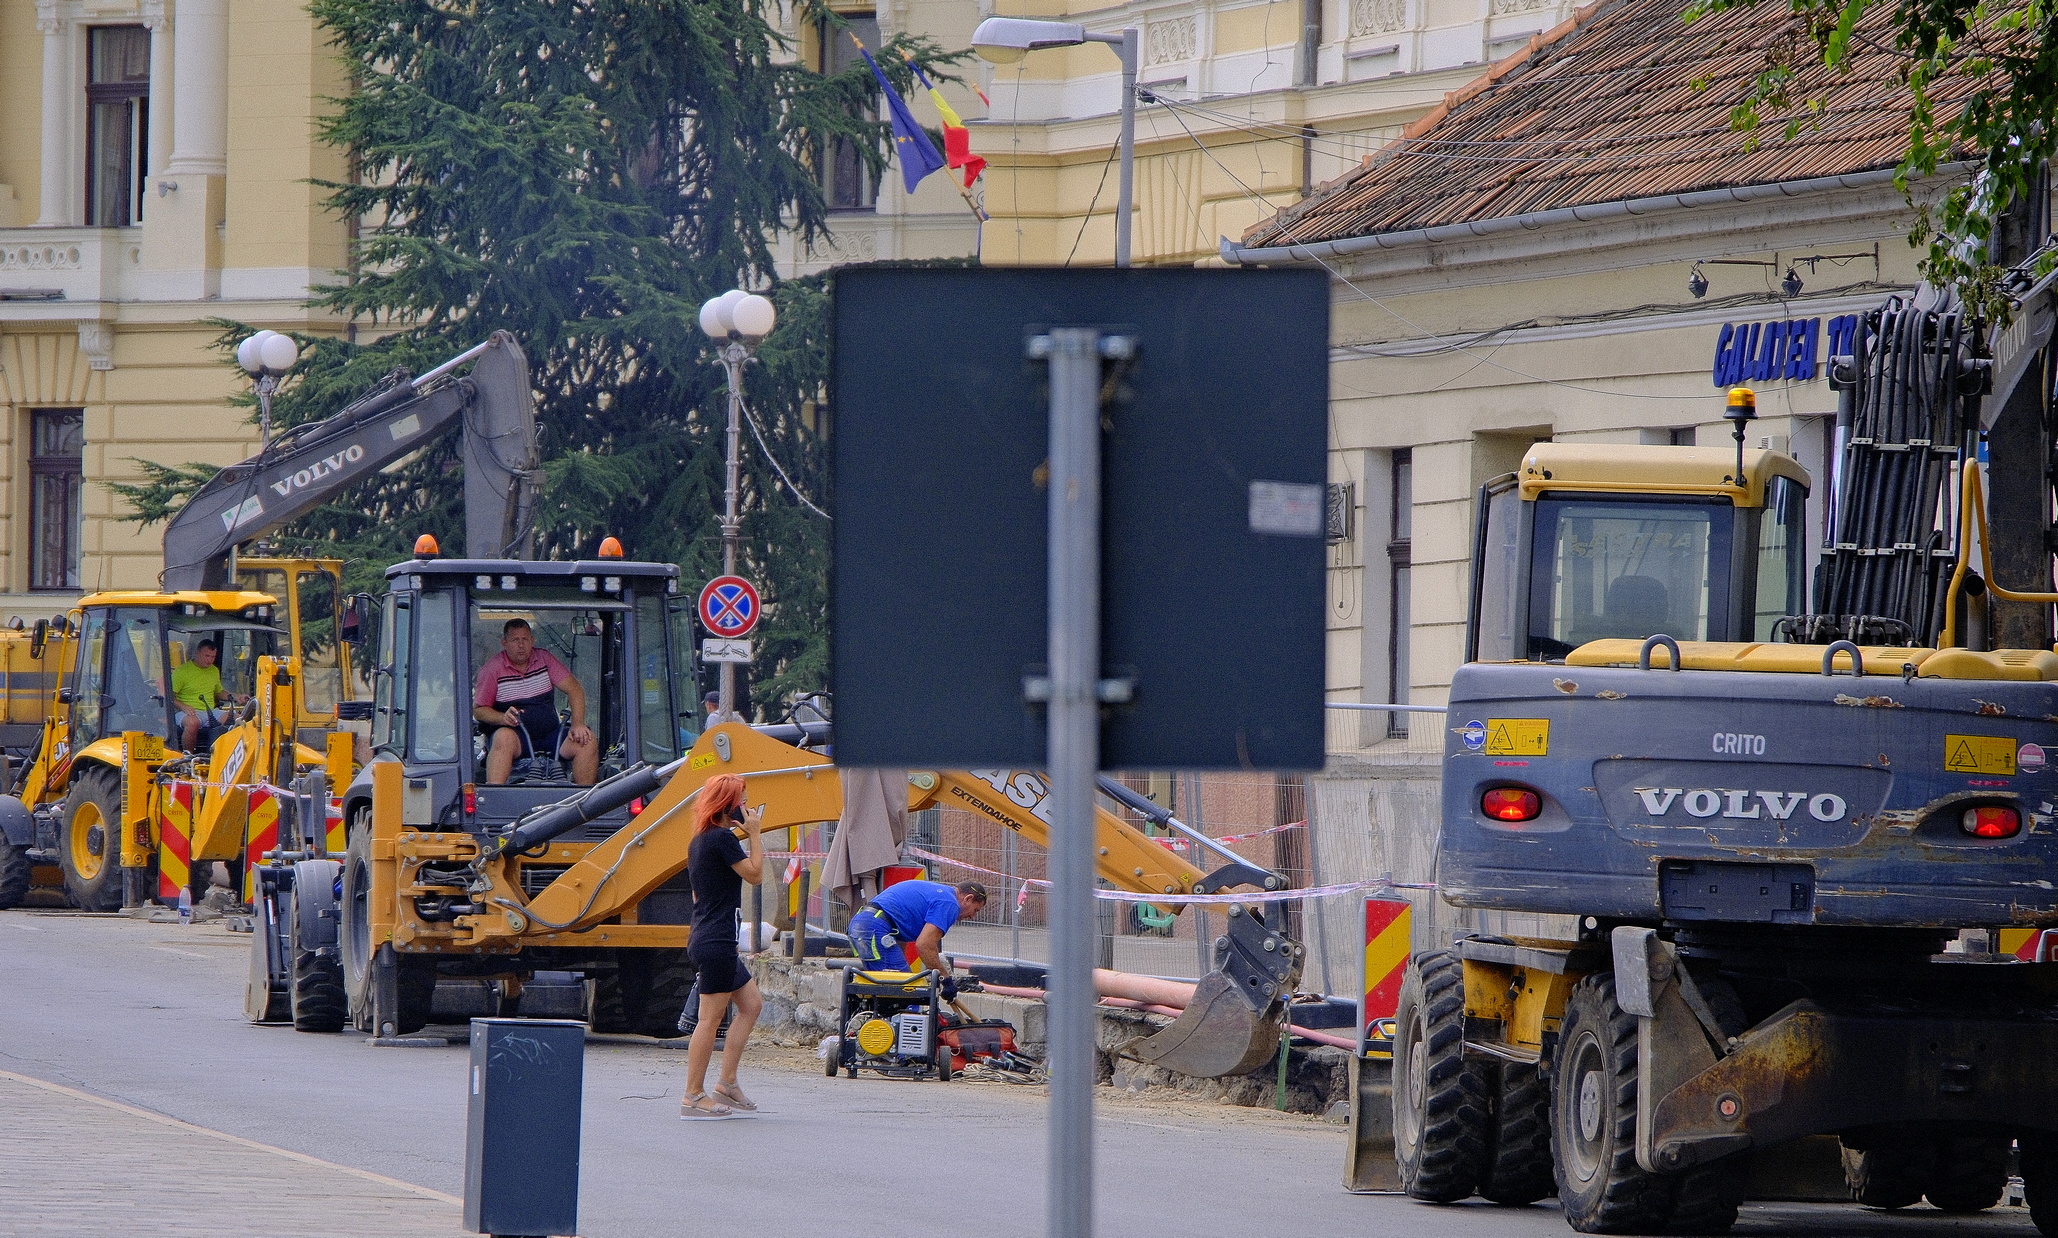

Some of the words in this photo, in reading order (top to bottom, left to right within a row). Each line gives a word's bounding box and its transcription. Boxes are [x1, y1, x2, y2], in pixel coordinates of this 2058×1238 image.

[1713, 316, 1821, 388] GALATEA
[1996, 312, 2027, 374] VOLVO
[270, 444, 364, 496] VOLVO
[137, 748, 161, 758] 01246
[220, 737, 245, 798] JCB
[1712, 732, 1766, 756] CRITO
[950, 786, 1023, 832] EXTENDAHOE
[1633, 787, 1848, 823] VOLVO
